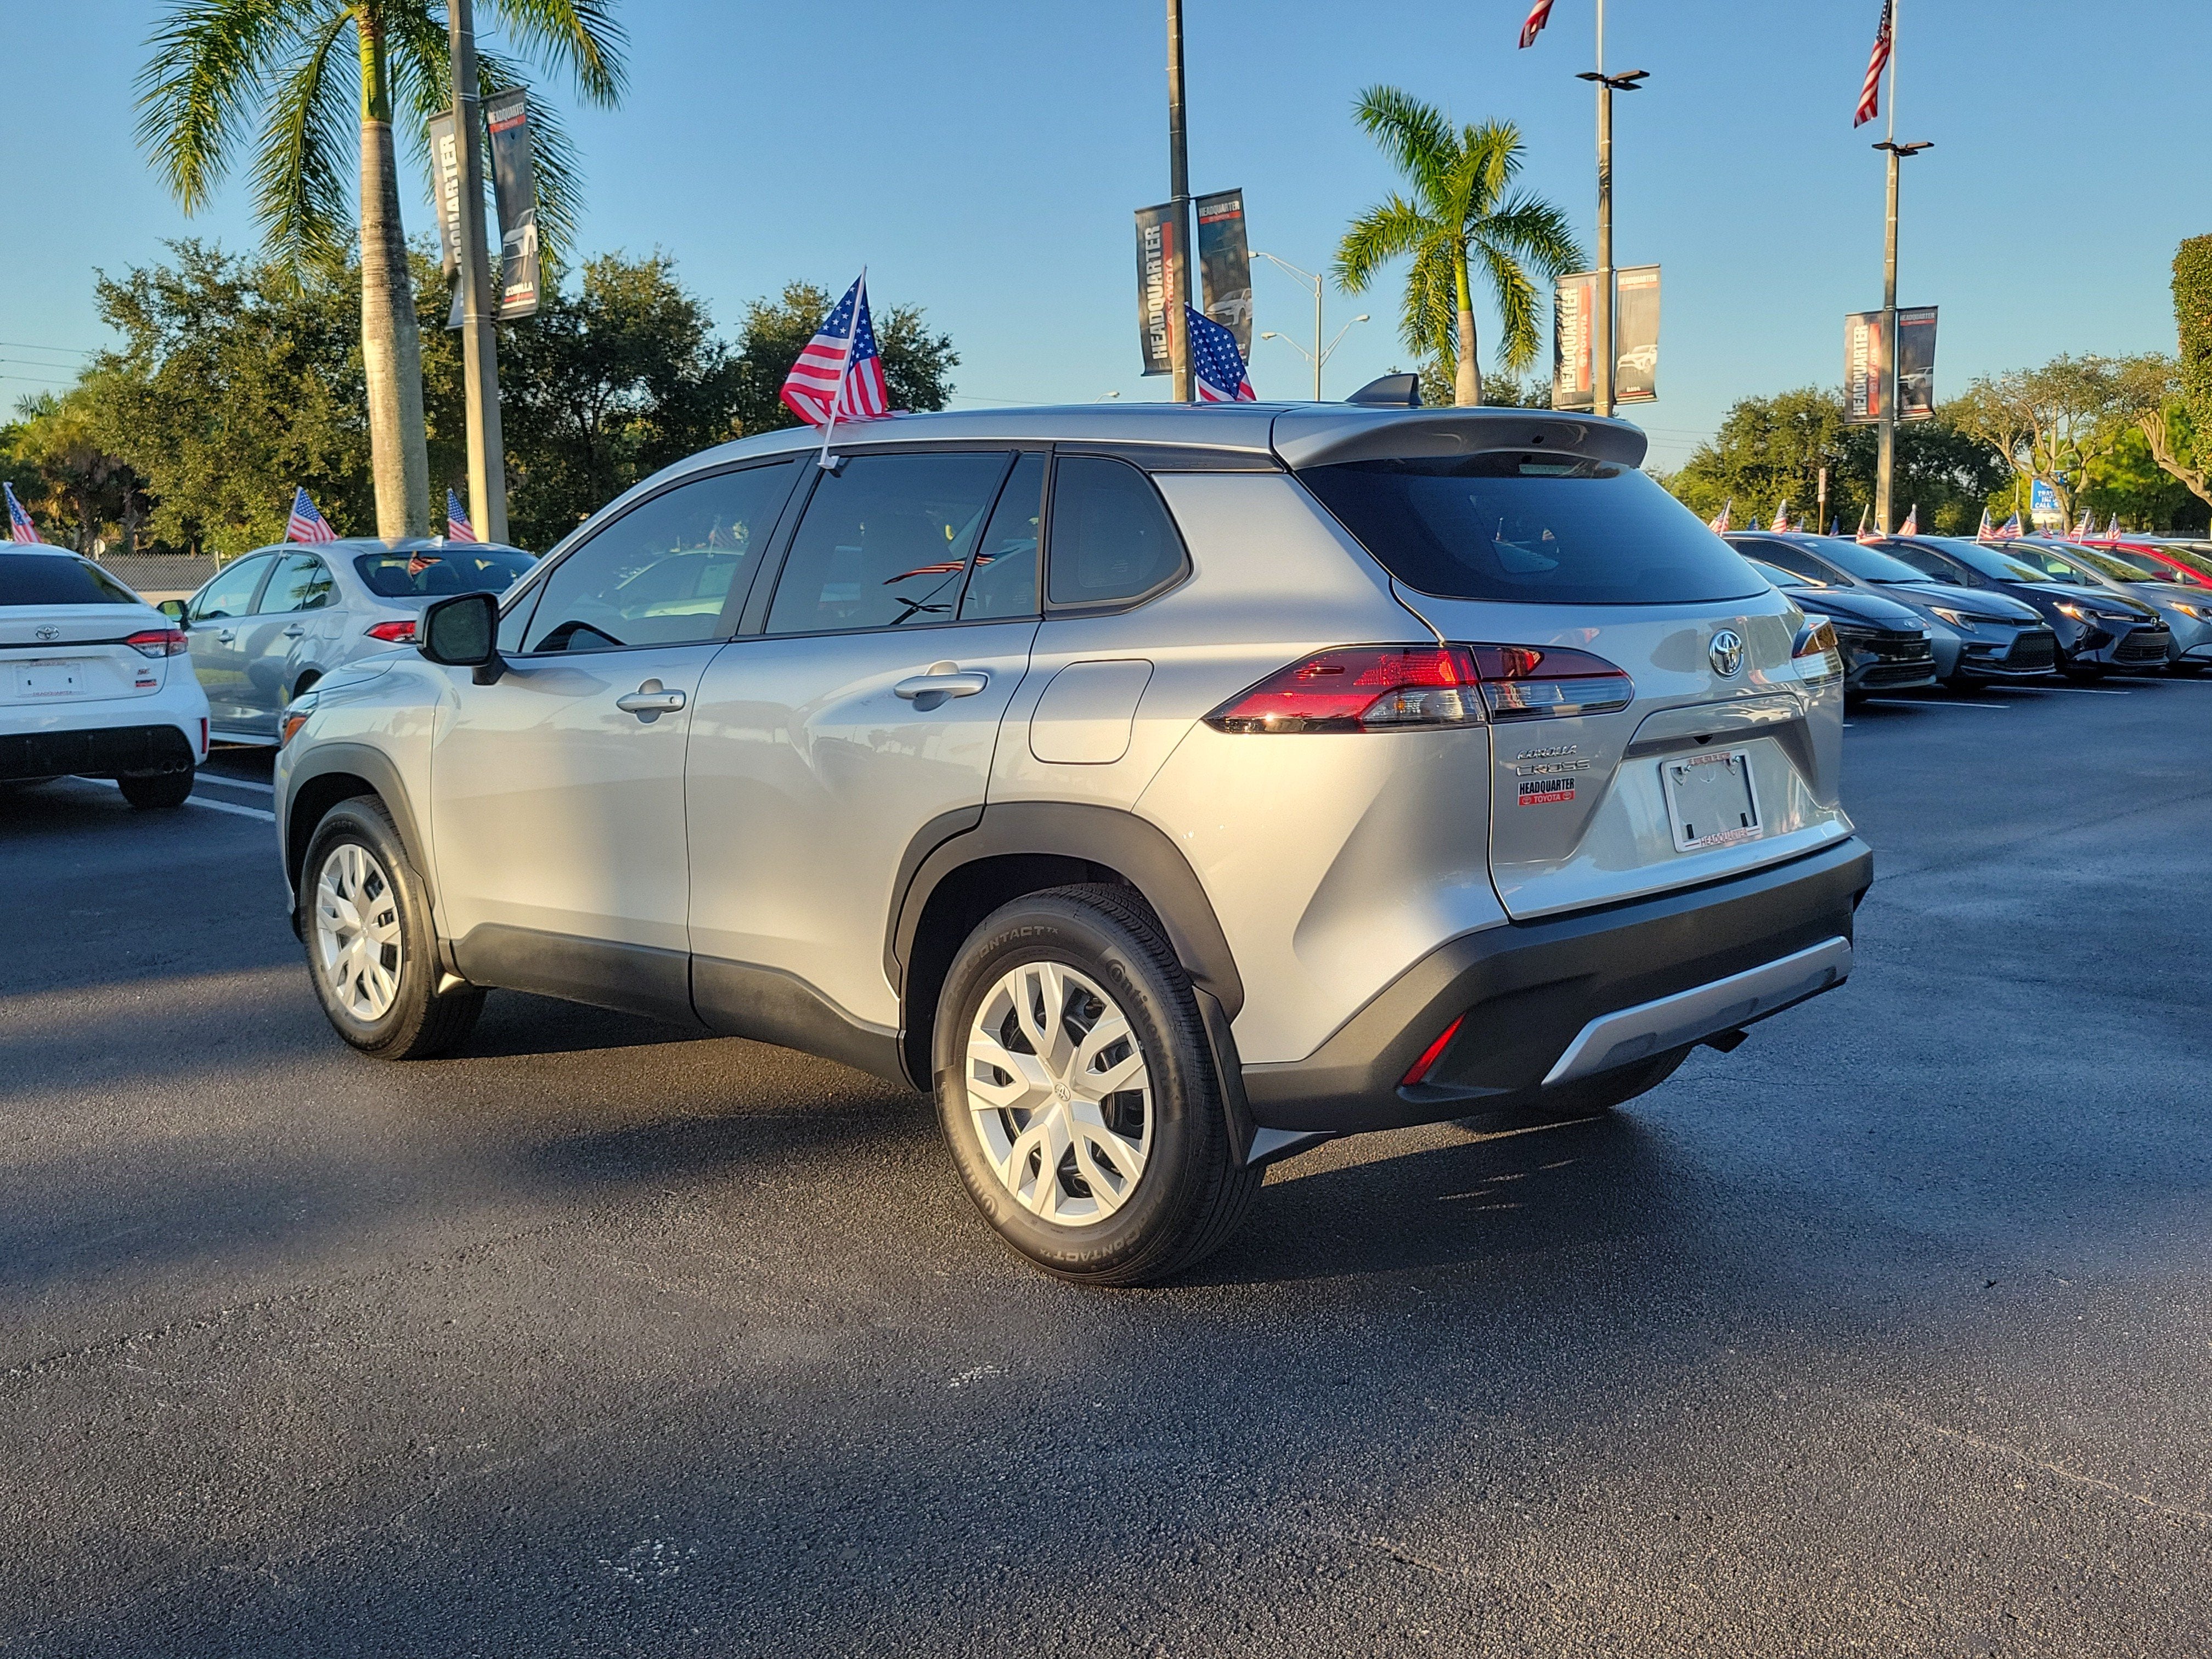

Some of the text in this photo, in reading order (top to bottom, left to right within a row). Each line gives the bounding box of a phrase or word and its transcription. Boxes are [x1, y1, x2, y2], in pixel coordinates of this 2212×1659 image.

[1198, 201, 1240, 217] HEADQUARTER
[439, 133, 463, 307] DQUARTER
[1144, 225, 1168, 359] HEADQUARTER
[1561, 287, 1578, 393] HEADQUARTER
[1853, 325, 1868, 416] HEADQUARTER
[1516, 744, 1577, 760] COROLLA
[1516, 759, 1590, 776] CROSS
[1519, 778, 1575, 795] HEADQUARTER
[1534, 794, 1561, 803] TOYOTA
[1701, 827, 1747, 846] HEADQUARTER
